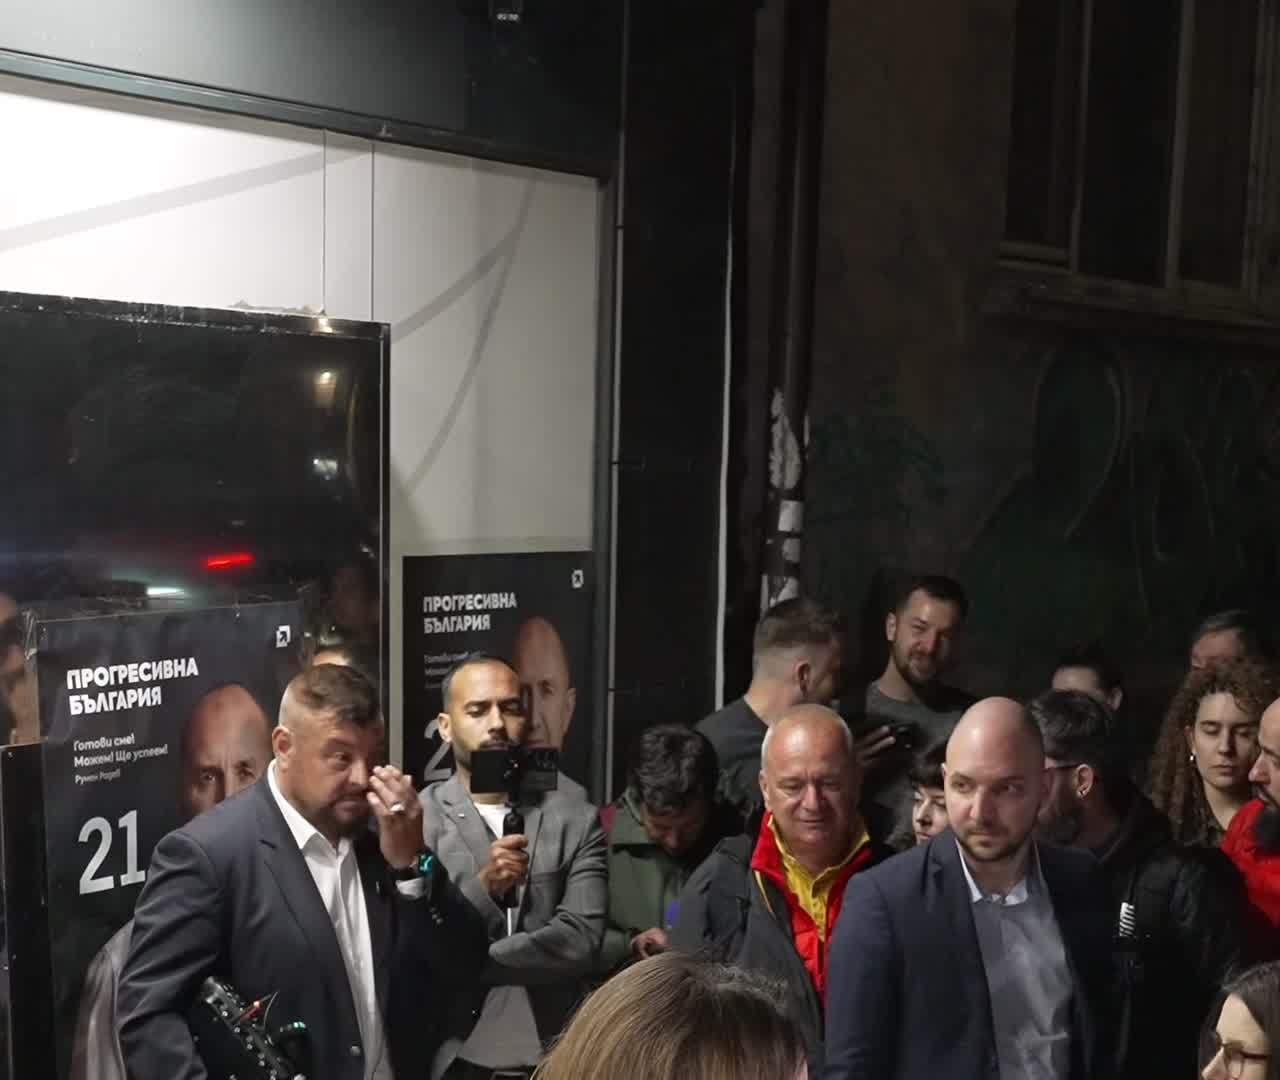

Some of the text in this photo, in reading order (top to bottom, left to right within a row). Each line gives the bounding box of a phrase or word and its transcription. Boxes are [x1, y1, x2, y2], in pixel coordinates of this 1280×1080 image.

[423, 592, 517, 613] ПРОГРЕСИВНА
[424, 614, 491, 634] БЪЛГАРИЯ
[66, 657, 199, 690] ПРОГРЕСИВНА
[69, 686, 162, 715] БЪЛГАРИЯ
[73, 733, 135, 752] Готови сме!
[74, 744, 168, 768] Можем! Ще успеем!
[78, 810, 146, 896] 21
